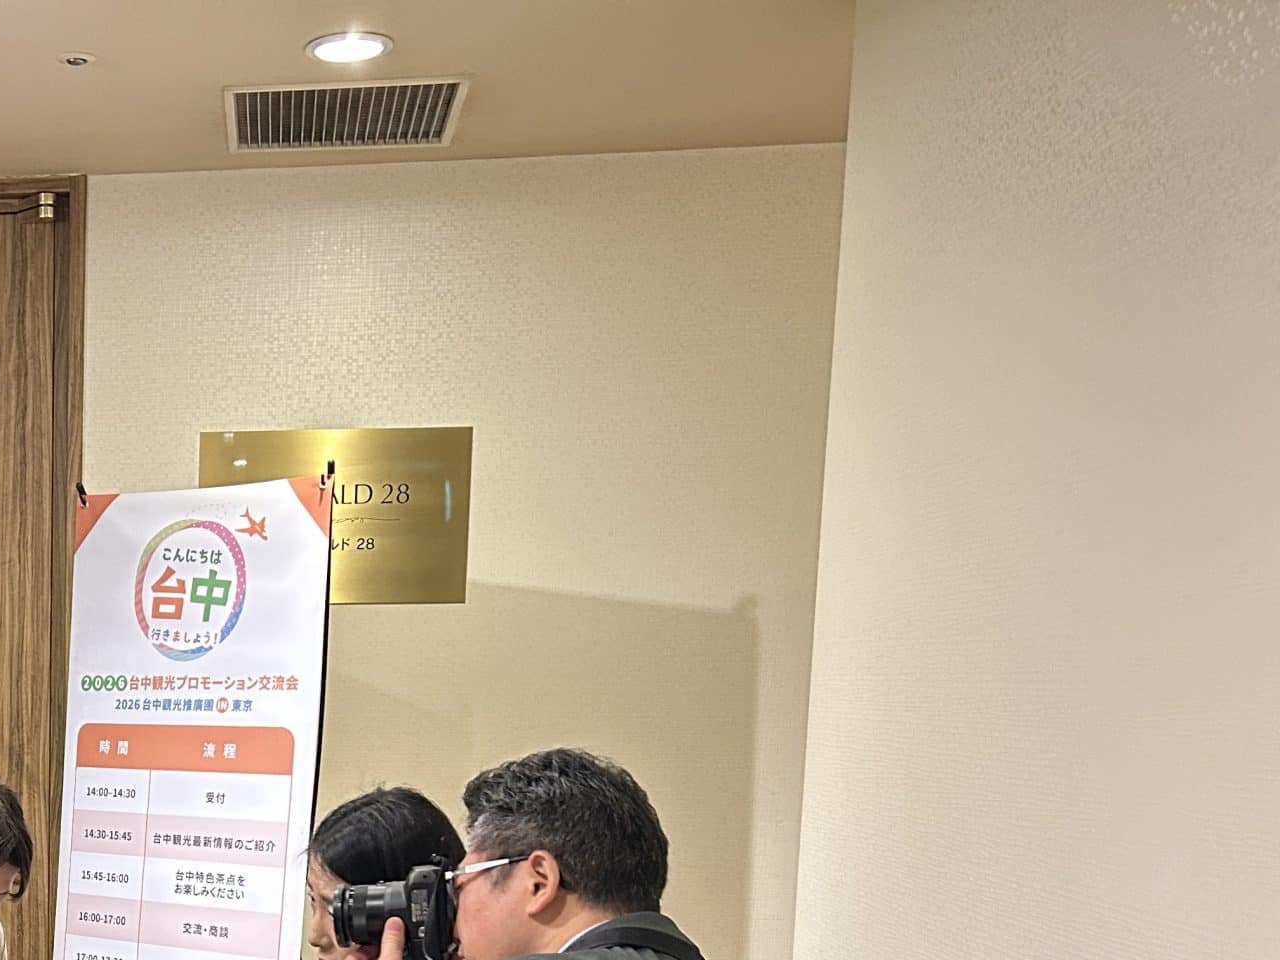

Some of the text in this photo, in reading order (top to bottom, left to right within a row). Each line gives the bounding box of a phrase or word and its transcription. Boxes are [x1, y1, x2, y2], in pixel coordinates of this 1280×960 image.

[332, 483, 410, 505] LD 28
[356, 538, 375, 550] 28
[162, 548, 222, 565] こんにちは
[151, 566, 232, 622] 台中
[86, 786, 136, 799] 14:00-14:30
[205, 791, 226, 804] 受付
[84, 828, 132, 842] 14:30-15:45
[81, 869, 129, 884] 15:45-16:00
[175, 869, 246, 887] 台中特色茶点を
[174, 883, 245, 900] お楽しみください
[78, 911, 126, 926] 16:00-17:00
